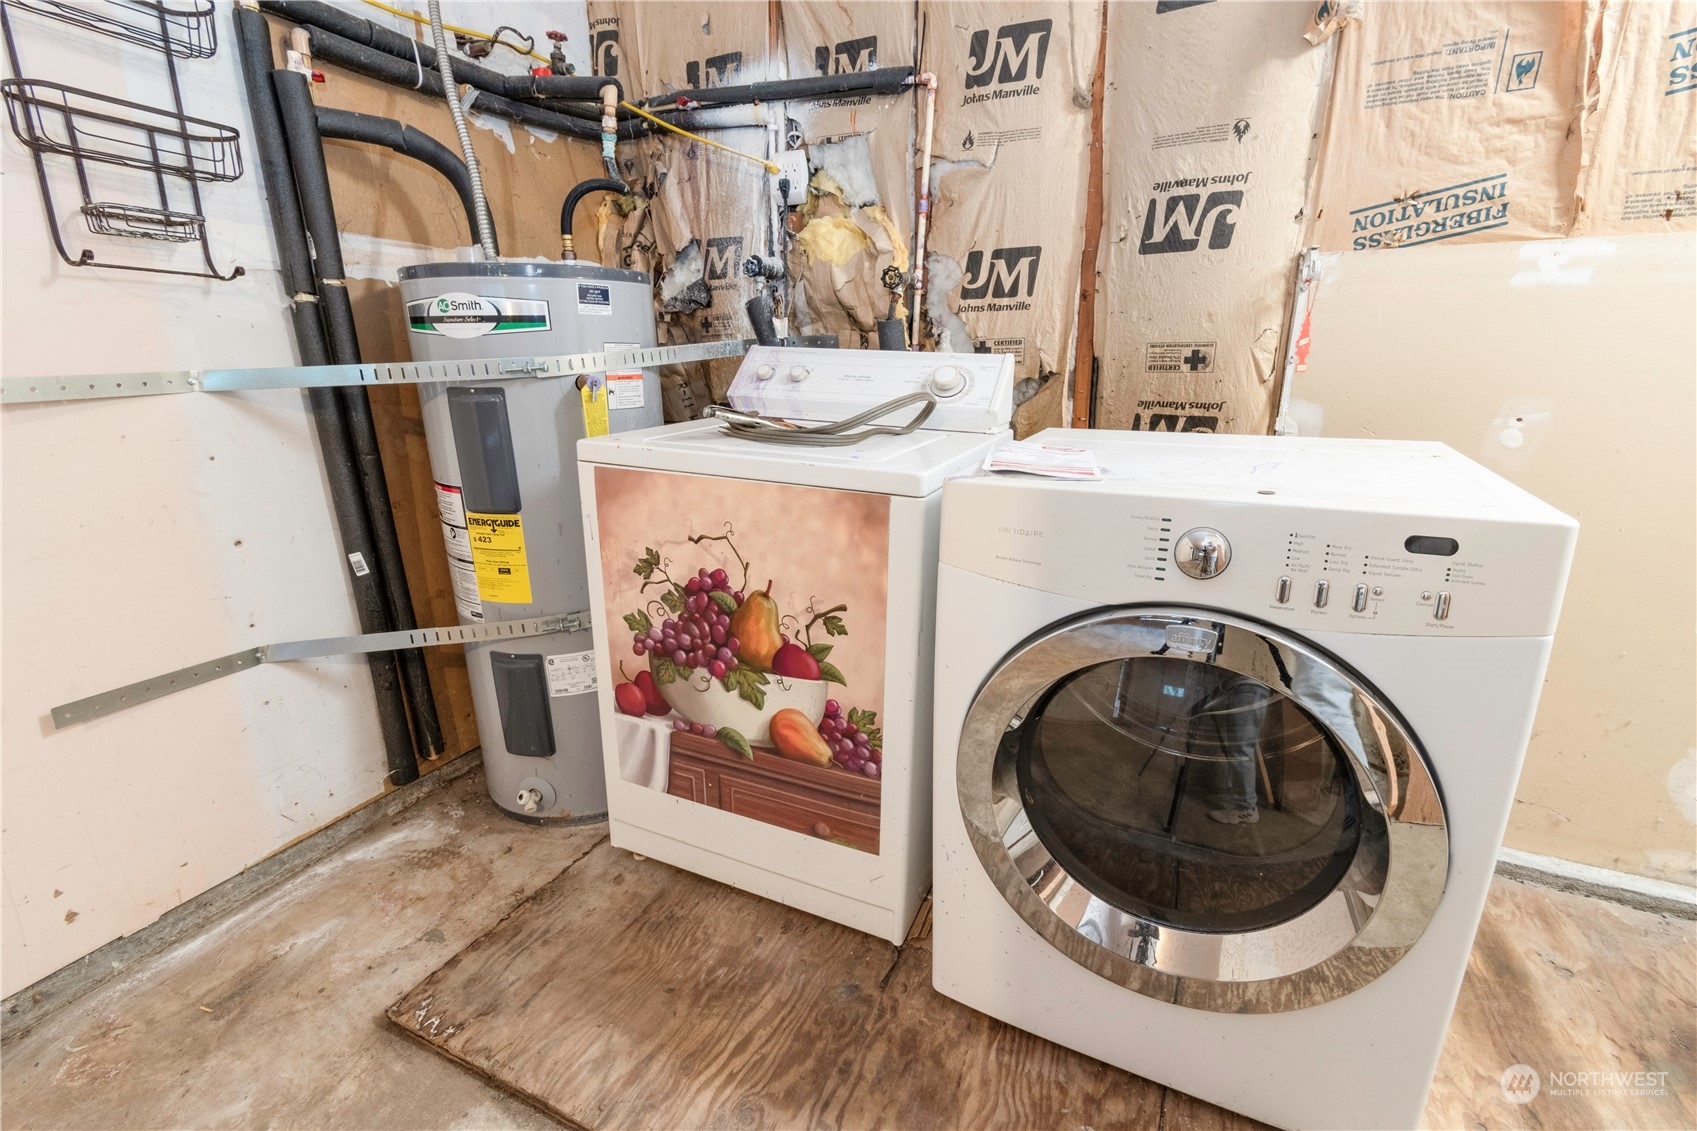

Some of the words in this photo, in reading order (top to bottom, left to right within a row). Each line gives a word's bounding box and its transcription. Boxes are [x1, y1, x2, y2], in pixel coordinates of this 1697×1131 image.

[965, 18, 1054, 88] JM
[1445, 42, 1496, 55] IMPORTANT:
[960, 92, 991, 106] Johns
[992, 85, 1040, 104] Manville
[1447, 89, 1486, 99] CAUTION:
[833, 96, 872, 107] Manville
[1211, 172, 1252, 185] Johns
[1352, 182, 1507, 233] INSULATION
[1138, 190, 1244, 255] JM
[958, 246, 1042, 300] JM
[451, 300, 481, 310] Smith
[957, 303, 986, 314] Johns
[986, 300, 1031, 312] Manville
[1137, 400, 1187, 411] Manville
[1189, 402, 1226, 412] Johns
[1171, 632, 1212, 649] affinity
